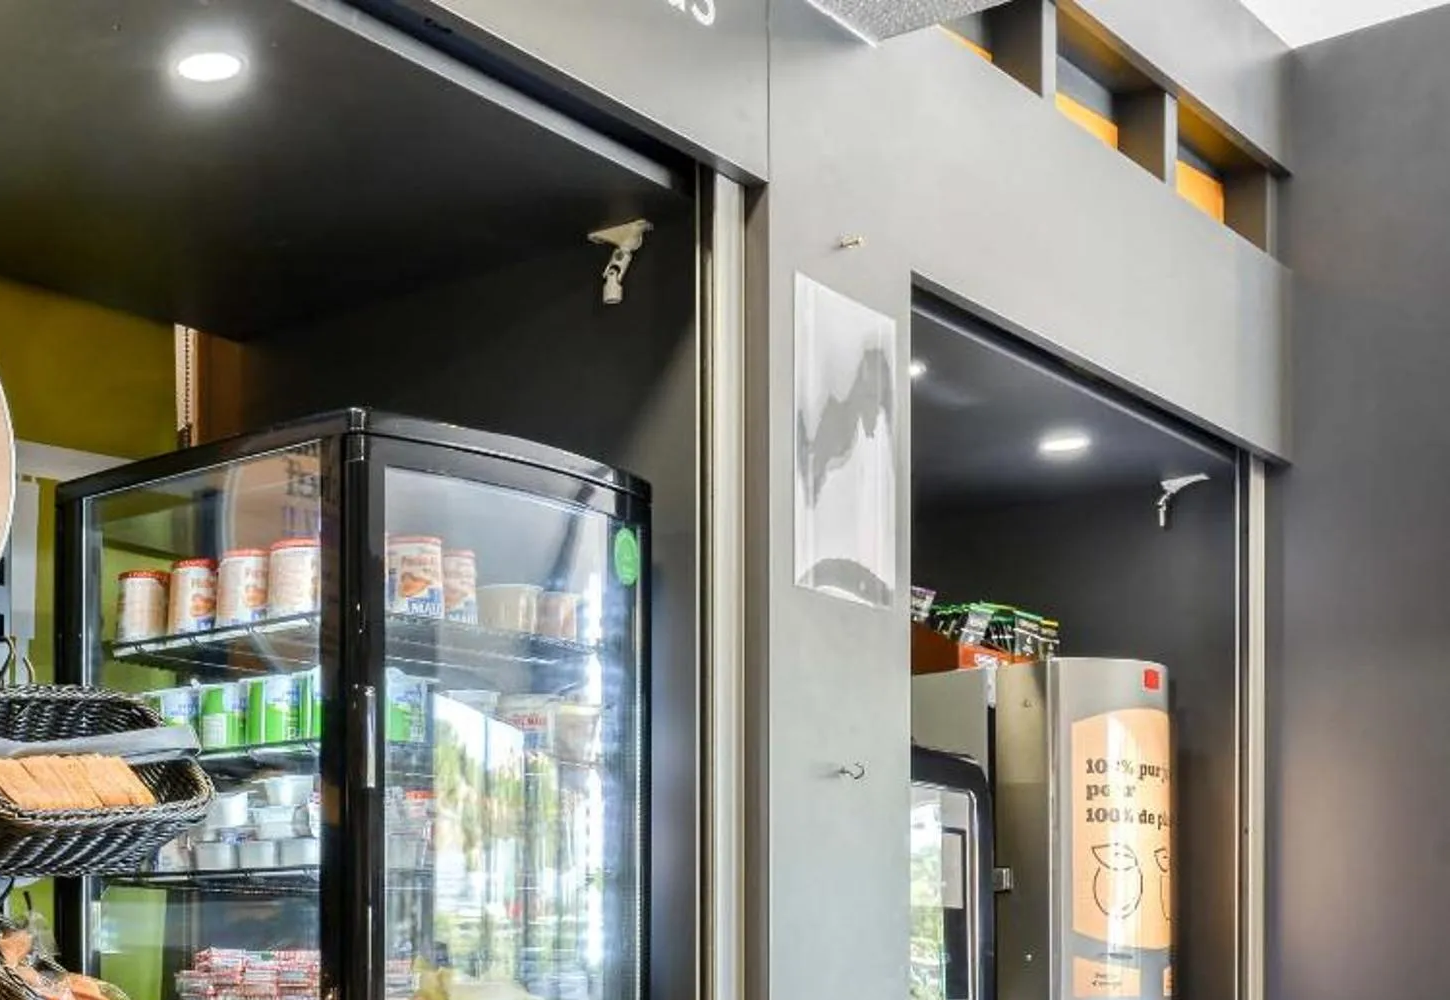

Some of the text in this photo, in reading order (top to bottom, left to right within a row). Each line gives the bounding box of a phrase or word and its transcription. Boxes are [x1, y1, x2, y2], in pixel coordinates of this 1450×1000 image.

[1085, 758, 1134, 775] 10%
[1085, 784, 1136, 801] por
[1138, 809, 1155, 825] de
